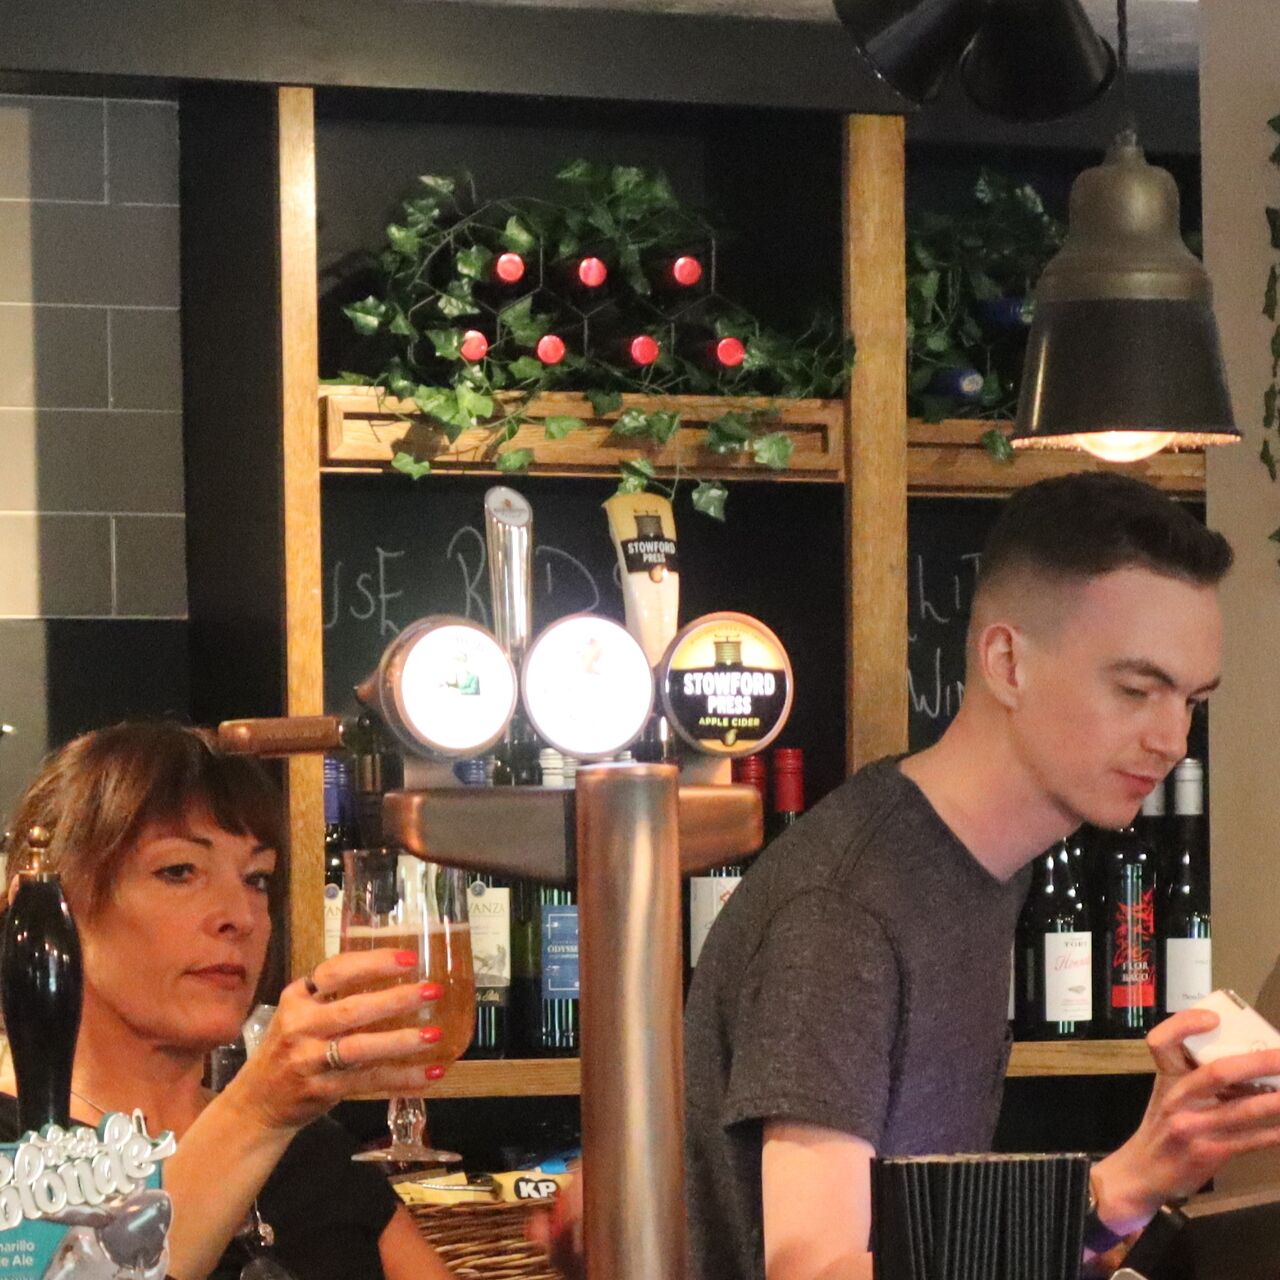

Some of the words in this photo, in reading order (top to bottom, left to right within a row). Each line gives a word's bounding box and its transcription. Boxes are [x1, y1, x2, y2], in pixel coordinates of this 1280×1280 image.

[627, 541, 676, 555] STOWFORD
[642, 552, 666, 563] PRESS
[683, 672, 776, 696] STOWFORD
[707, 695, 752, 715] PRESS
[698, 716, 729, 728] APPLE
[731, 717, 761, 728] CIDER
[519, 1180, 557, 1199] KP
[11, 1254, 34, 1267] Ale
